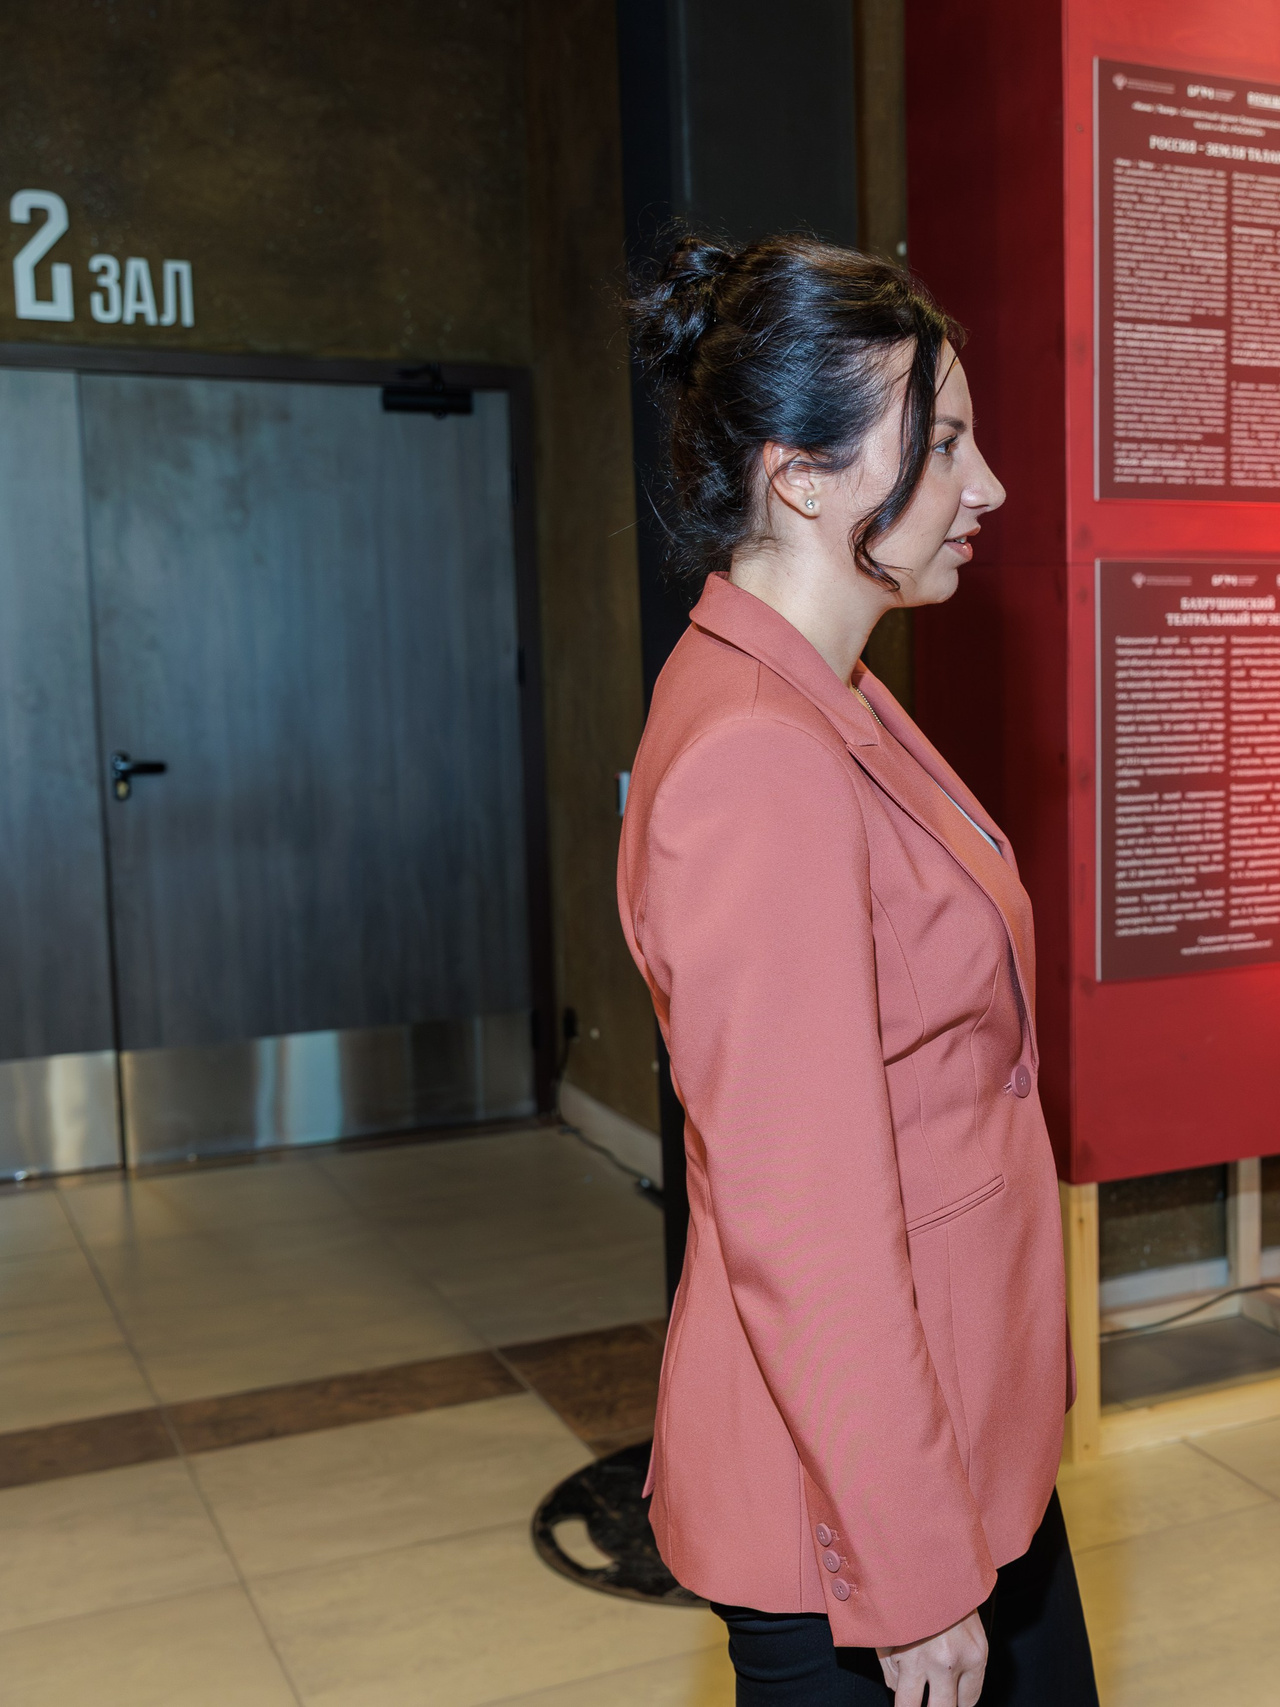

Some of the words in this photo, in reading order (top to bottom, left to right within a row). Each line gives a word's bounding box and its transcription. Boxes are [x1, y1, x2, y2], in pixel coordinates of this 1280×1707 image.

[1149, 135, 1197, 155] РОССИЯ
[1205, 142, 1245, 161] ЗЕМЛЯ
[9, 188, 75, 322] 2
[88, 254, 195, 328] ЗАЛ
[1180, 595, 1276, 611] БАХРУШИНСКИЙ
[1165, 611, 1250, 627] ТЕАТРАЛЬНЫЙ
